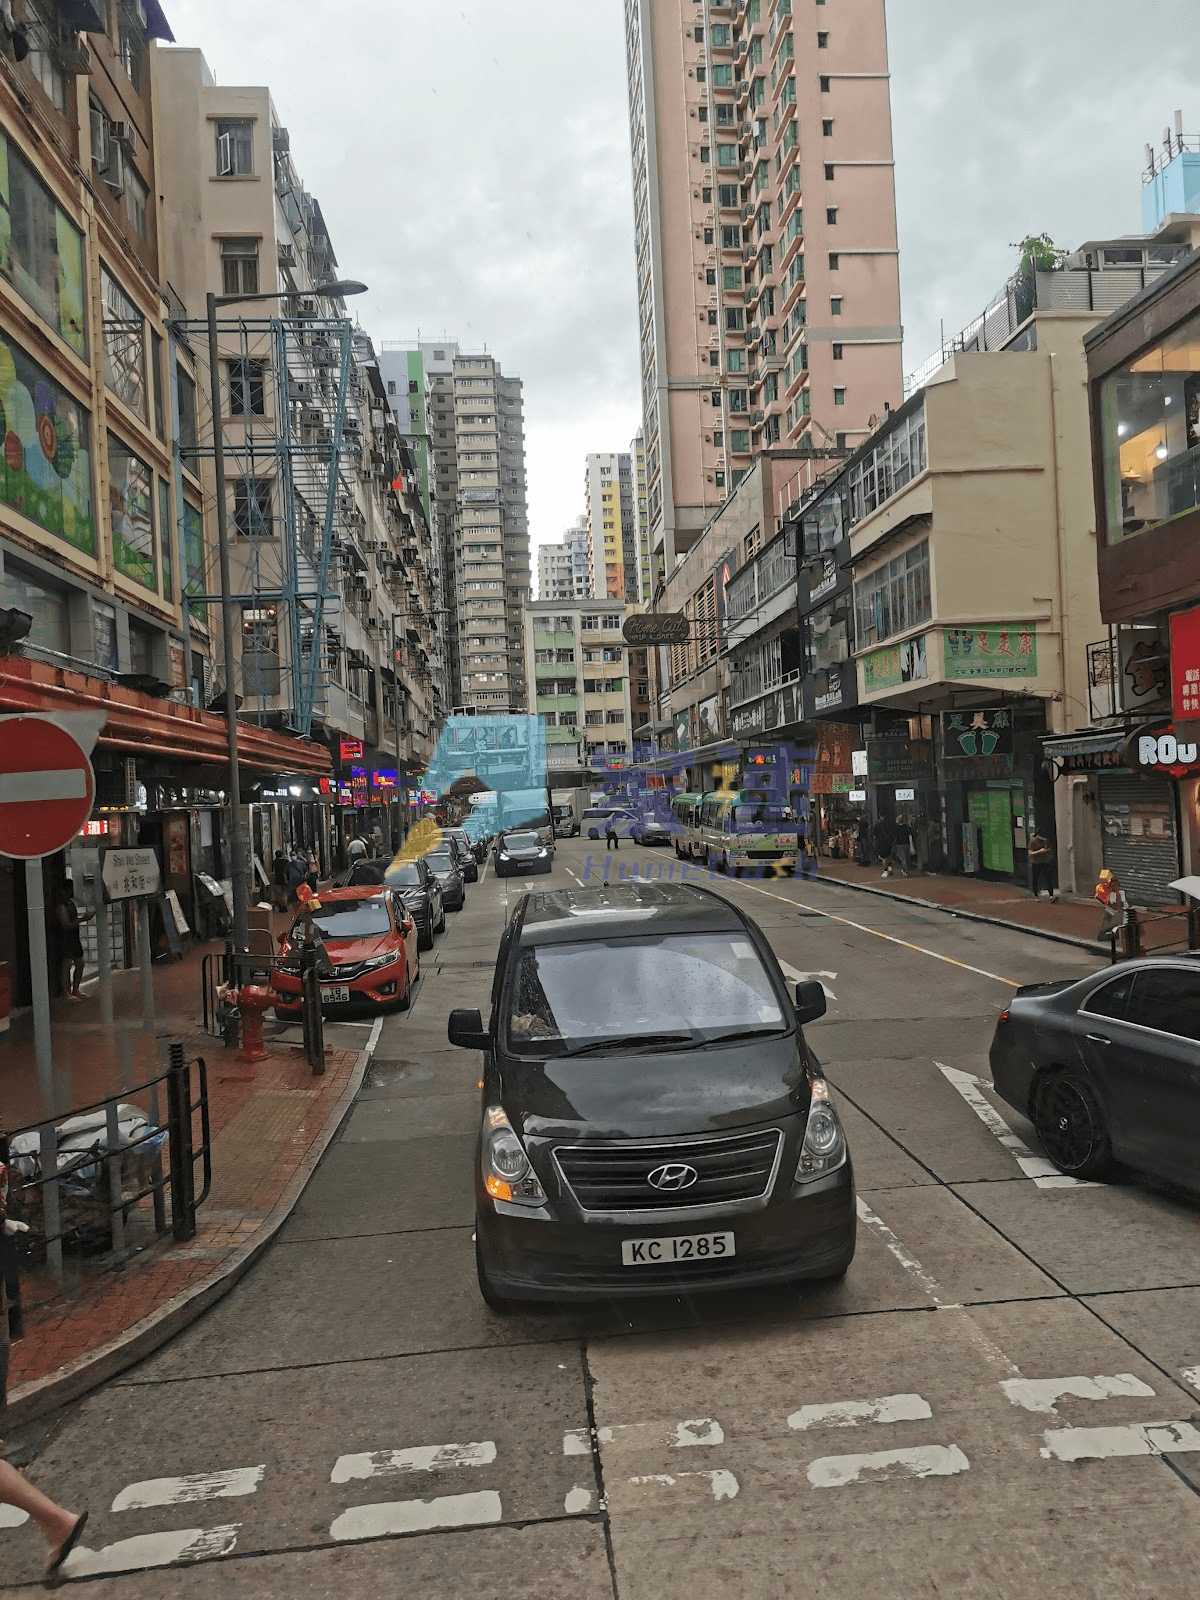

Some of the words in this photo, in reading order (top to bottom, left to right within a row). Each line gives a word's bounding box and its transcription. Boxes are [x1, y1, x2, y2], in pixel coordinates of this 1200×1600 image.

[1185, 668, 1200, 682] 電話
[947, 710, 1011, 732] 足美康
[631, 1241, 663, 1262] KC
[672, 1235, 727, 1260] 1285
